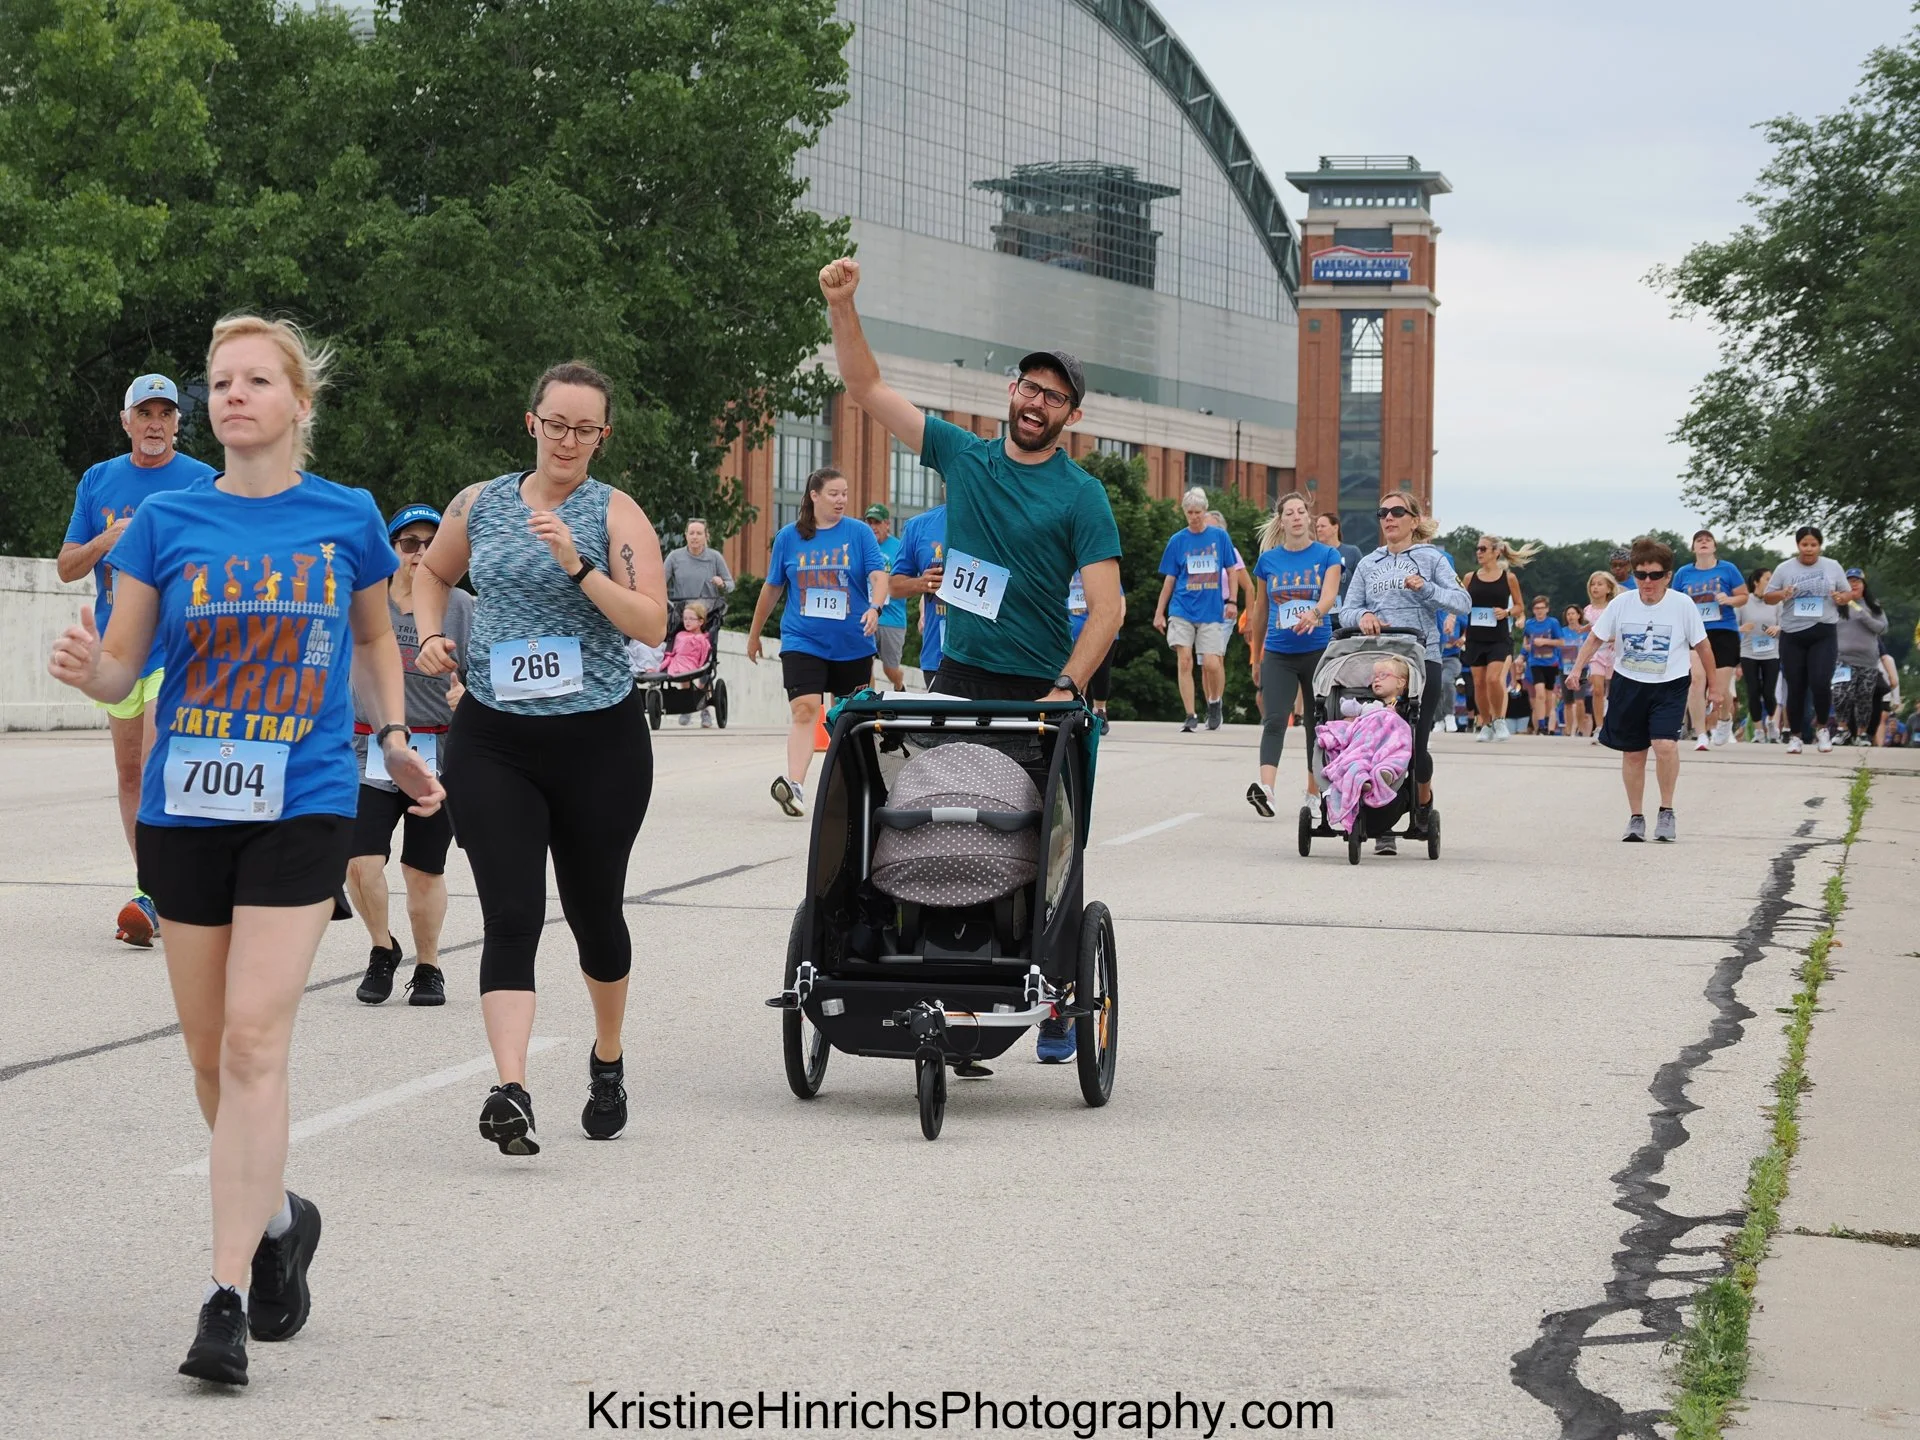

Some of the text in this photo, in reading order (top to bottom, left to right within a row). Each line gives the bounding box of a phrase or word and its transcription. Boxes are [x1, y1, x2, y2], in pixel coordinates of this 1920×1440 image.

[1313, 258, 1409, 270] AMERICAN FAMILY
[1319, 270, 1401, 278] INSURANCE
[953, 566, 988, 597] 514
[1372, 579, 1408, 594] BREWE
[816, 597, 837, 609] 113
[1801, 602, 1816, 611] 572
[1478, 612, 1488, 620] 34
[511, 651, 561, 683] 266
[183, 760, 265, 797] 7004
